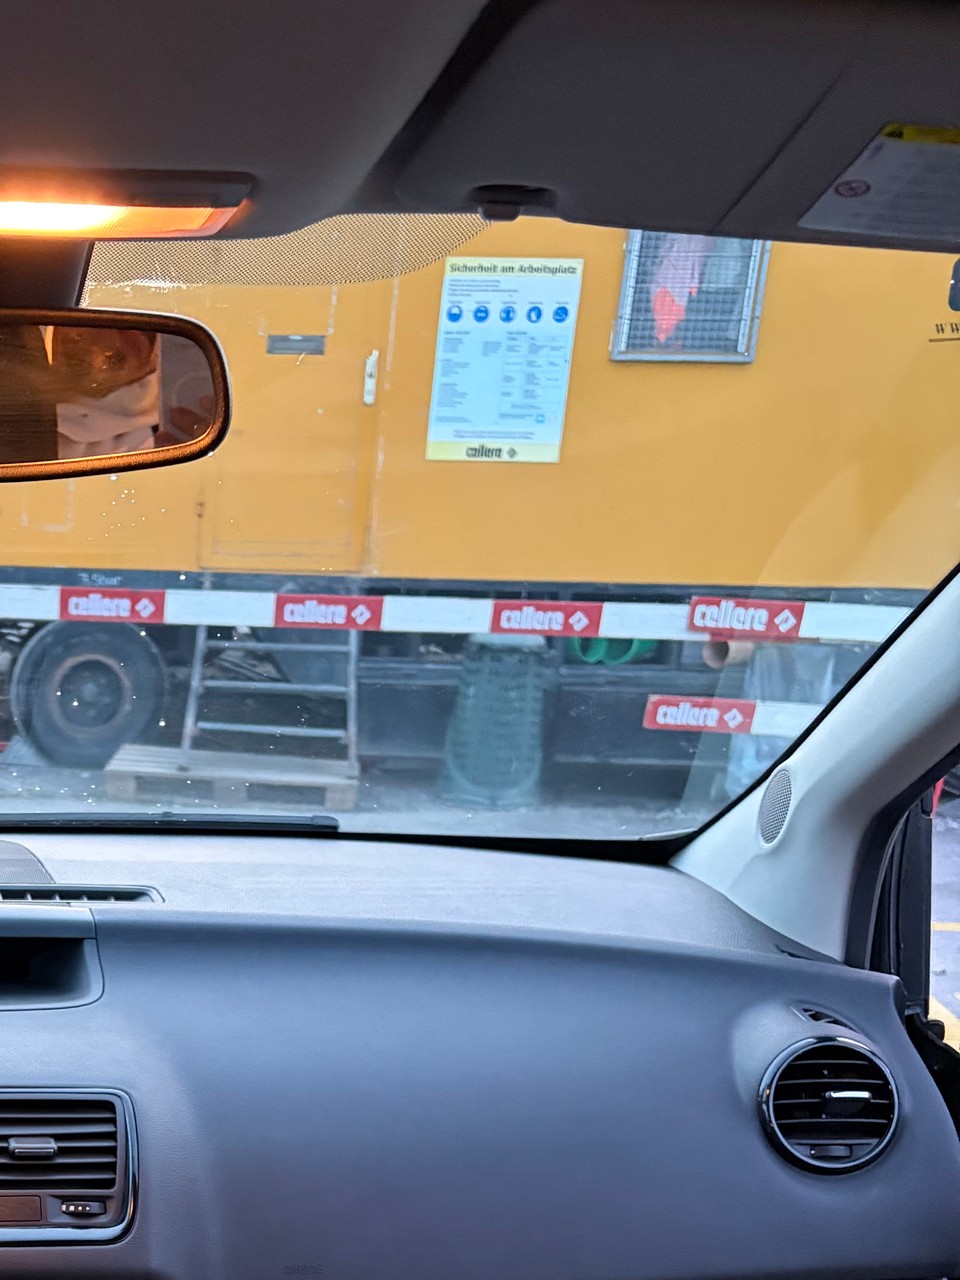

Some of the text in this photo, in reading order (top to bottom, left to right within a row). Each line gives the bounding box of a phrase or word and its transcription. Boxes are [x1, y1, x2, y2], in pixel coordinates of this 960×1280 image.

[449, 263, 498, 272] Sicherheit
[518, 264, 577, 274] Arbeitsplatz
[68, 593, 131, 617] cellere
[283, 601, 347, 625] cellere
[693, 601, 768, 631] cellere
[500, 607, 564, 631] cellere
[656, 703, 719, 727] cellere
